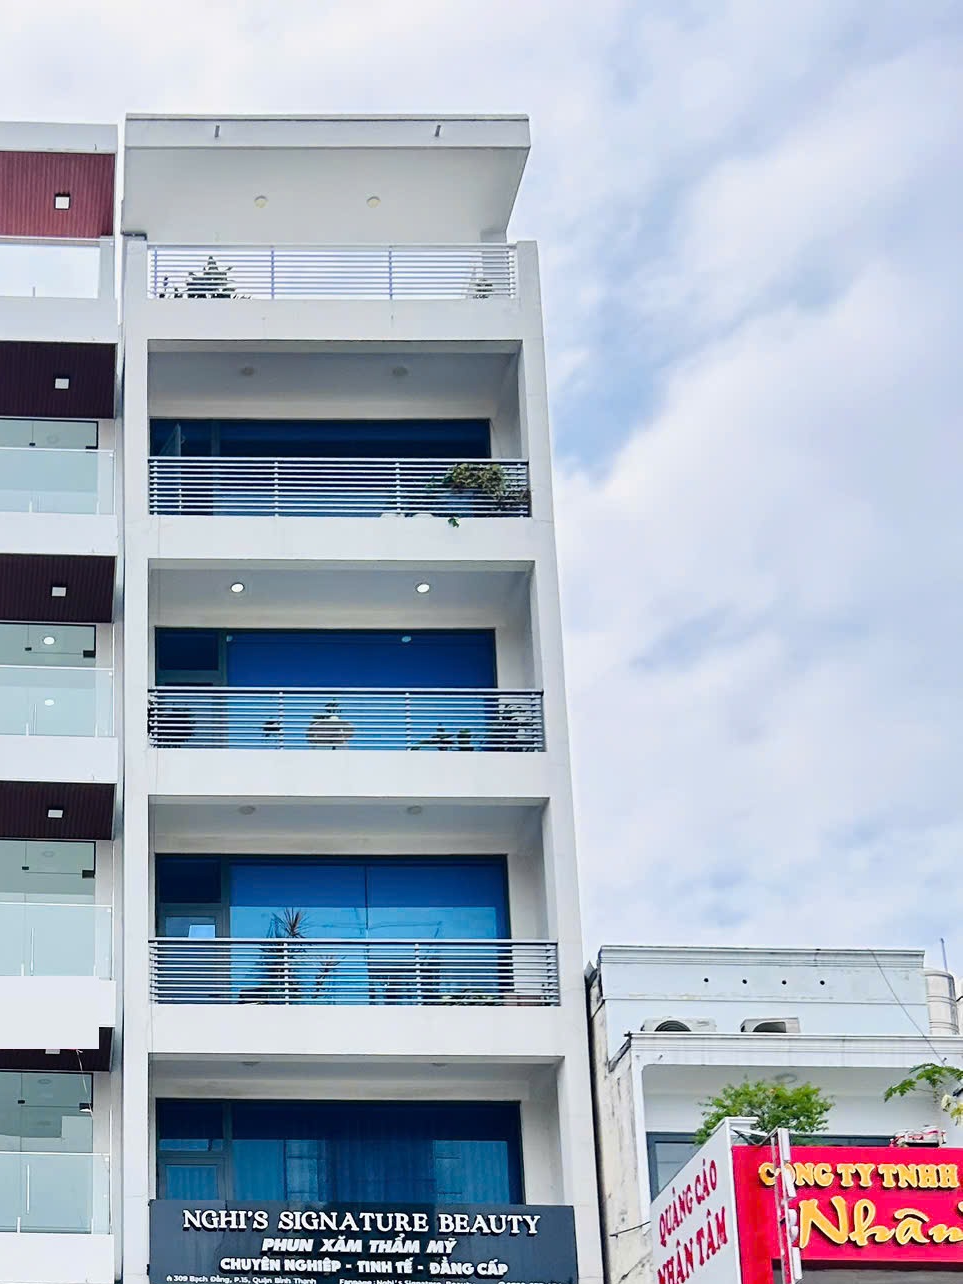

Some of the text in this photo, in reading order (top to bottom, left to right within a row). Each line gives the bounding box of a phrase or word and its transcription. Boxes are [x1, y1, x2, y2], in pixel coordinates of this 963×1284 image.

[695, 1158, 718, 1206] CÁO
[837, 1163, 875, 1188] TY
[878, 1164, 960, 1189] TNHH
[182, 1209, 541, 1235] NGHI'S SIGNATURE BEAUTY
[261, 1233, 458, 1255] PHUN XĂM THẨM MỸ
[696, 1206, 729, 1267] TÂM
[220, 1256, 281, 1272] CHUYÊN
[284, 1257, 342, 1276] NGHIỆP
[356, 1260, 393, 1274] TINH
[395, 1257, 413, 1274] TẾ
[477, 1258, 509, 1276] CẤP
[189, 1275, 208, 1284] Bạch
